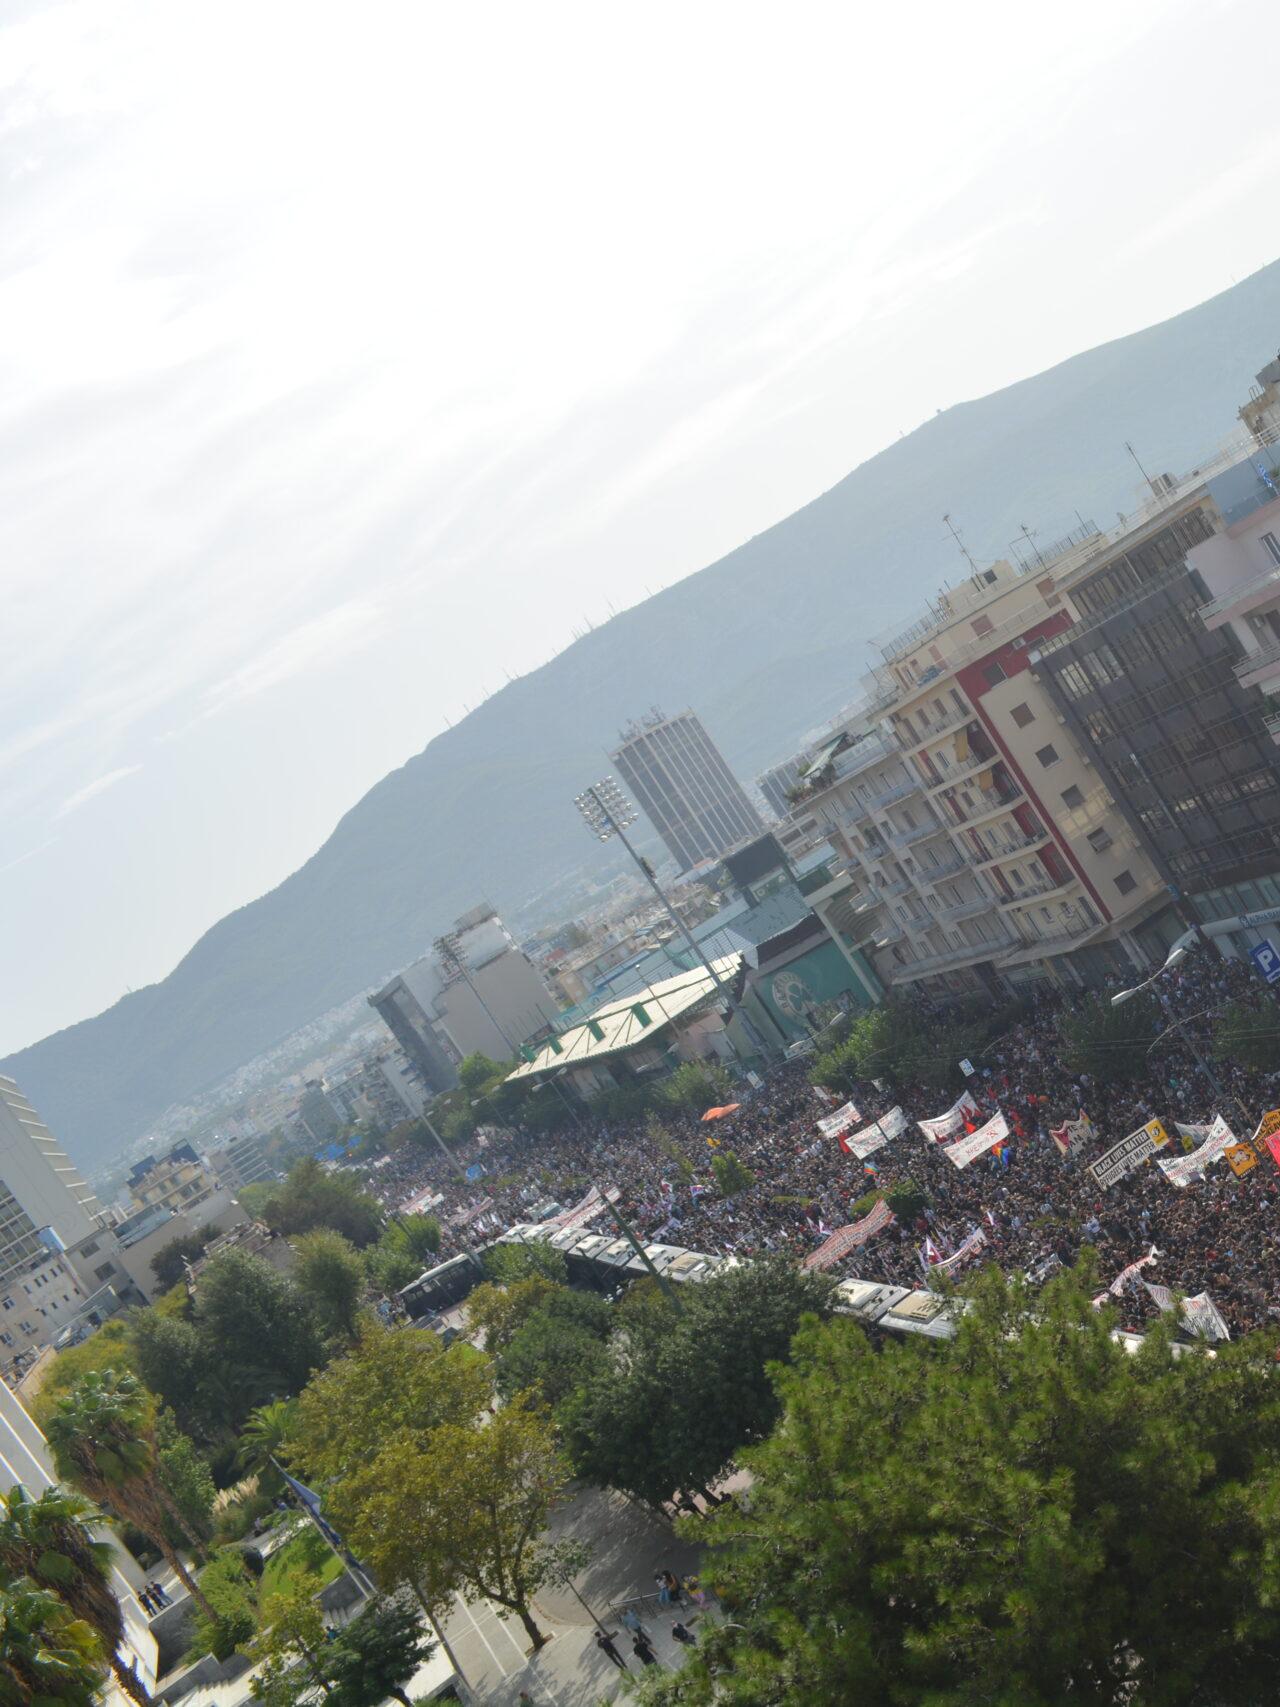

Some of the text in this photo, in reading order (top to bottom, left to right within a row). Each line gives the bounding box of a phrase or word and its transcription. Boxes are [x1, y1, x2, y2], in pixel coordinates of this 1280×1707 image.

[1257, 949, 1274, 973] P
[1095, 1131, 1150, 1176] BLACK LIVES MATTER
[1120, 1153, 1137, 1169] LIVES
[1133, 1140, 1157, 1161] MATTER
